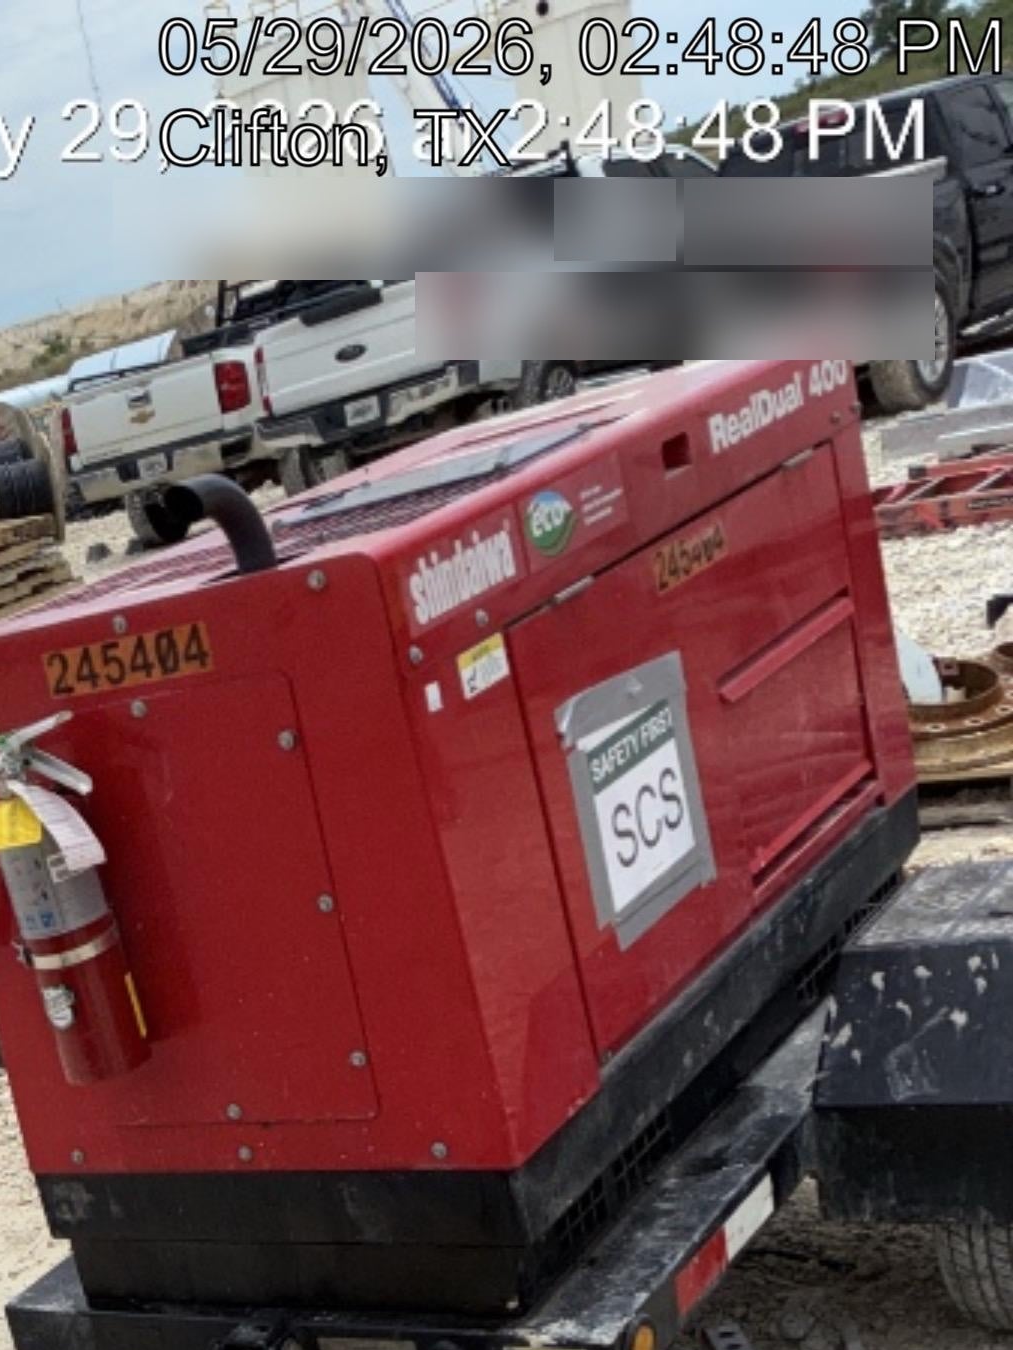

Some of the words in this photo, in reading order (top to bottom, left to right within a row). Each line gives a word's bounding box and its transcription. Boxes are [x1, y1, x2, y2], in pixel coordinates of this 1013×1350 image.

[708, 371, 805, 454] RealDual
[808, 360, 848, 397] 400
[46, 623, 210, 695] 245404
[590, 733, 639, 782] SAFETY
[640, 706, 674, 746] FIRST
[611, 766, 684, 868] SCS
